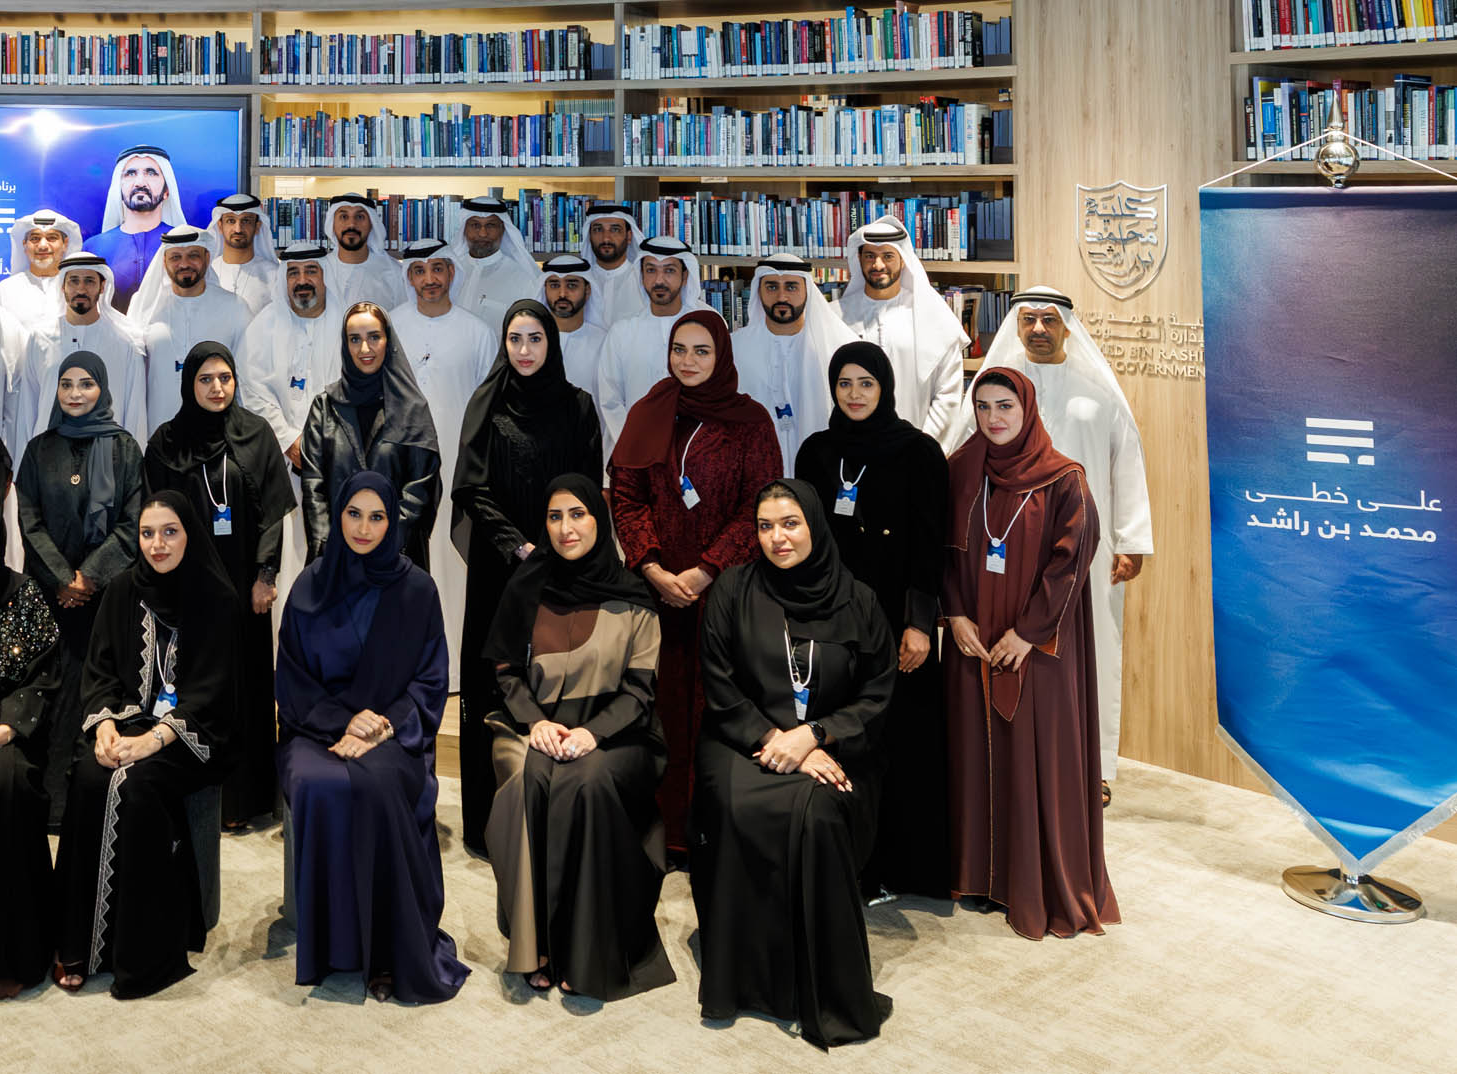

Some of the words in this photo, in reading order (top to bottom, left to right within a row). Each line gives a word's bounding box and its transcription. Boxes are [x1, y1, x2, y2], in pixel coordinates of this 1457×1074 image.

[1130, 347, 1154, 360] BIN
[1246, 482, 1349, 504] خطى
[1356, 490, 1442, 512] على
[1247, 508, 1309, 536] راشد
[1318, 520, 1351, 541] بن
[1360, 524, 1437, 543] محمد
